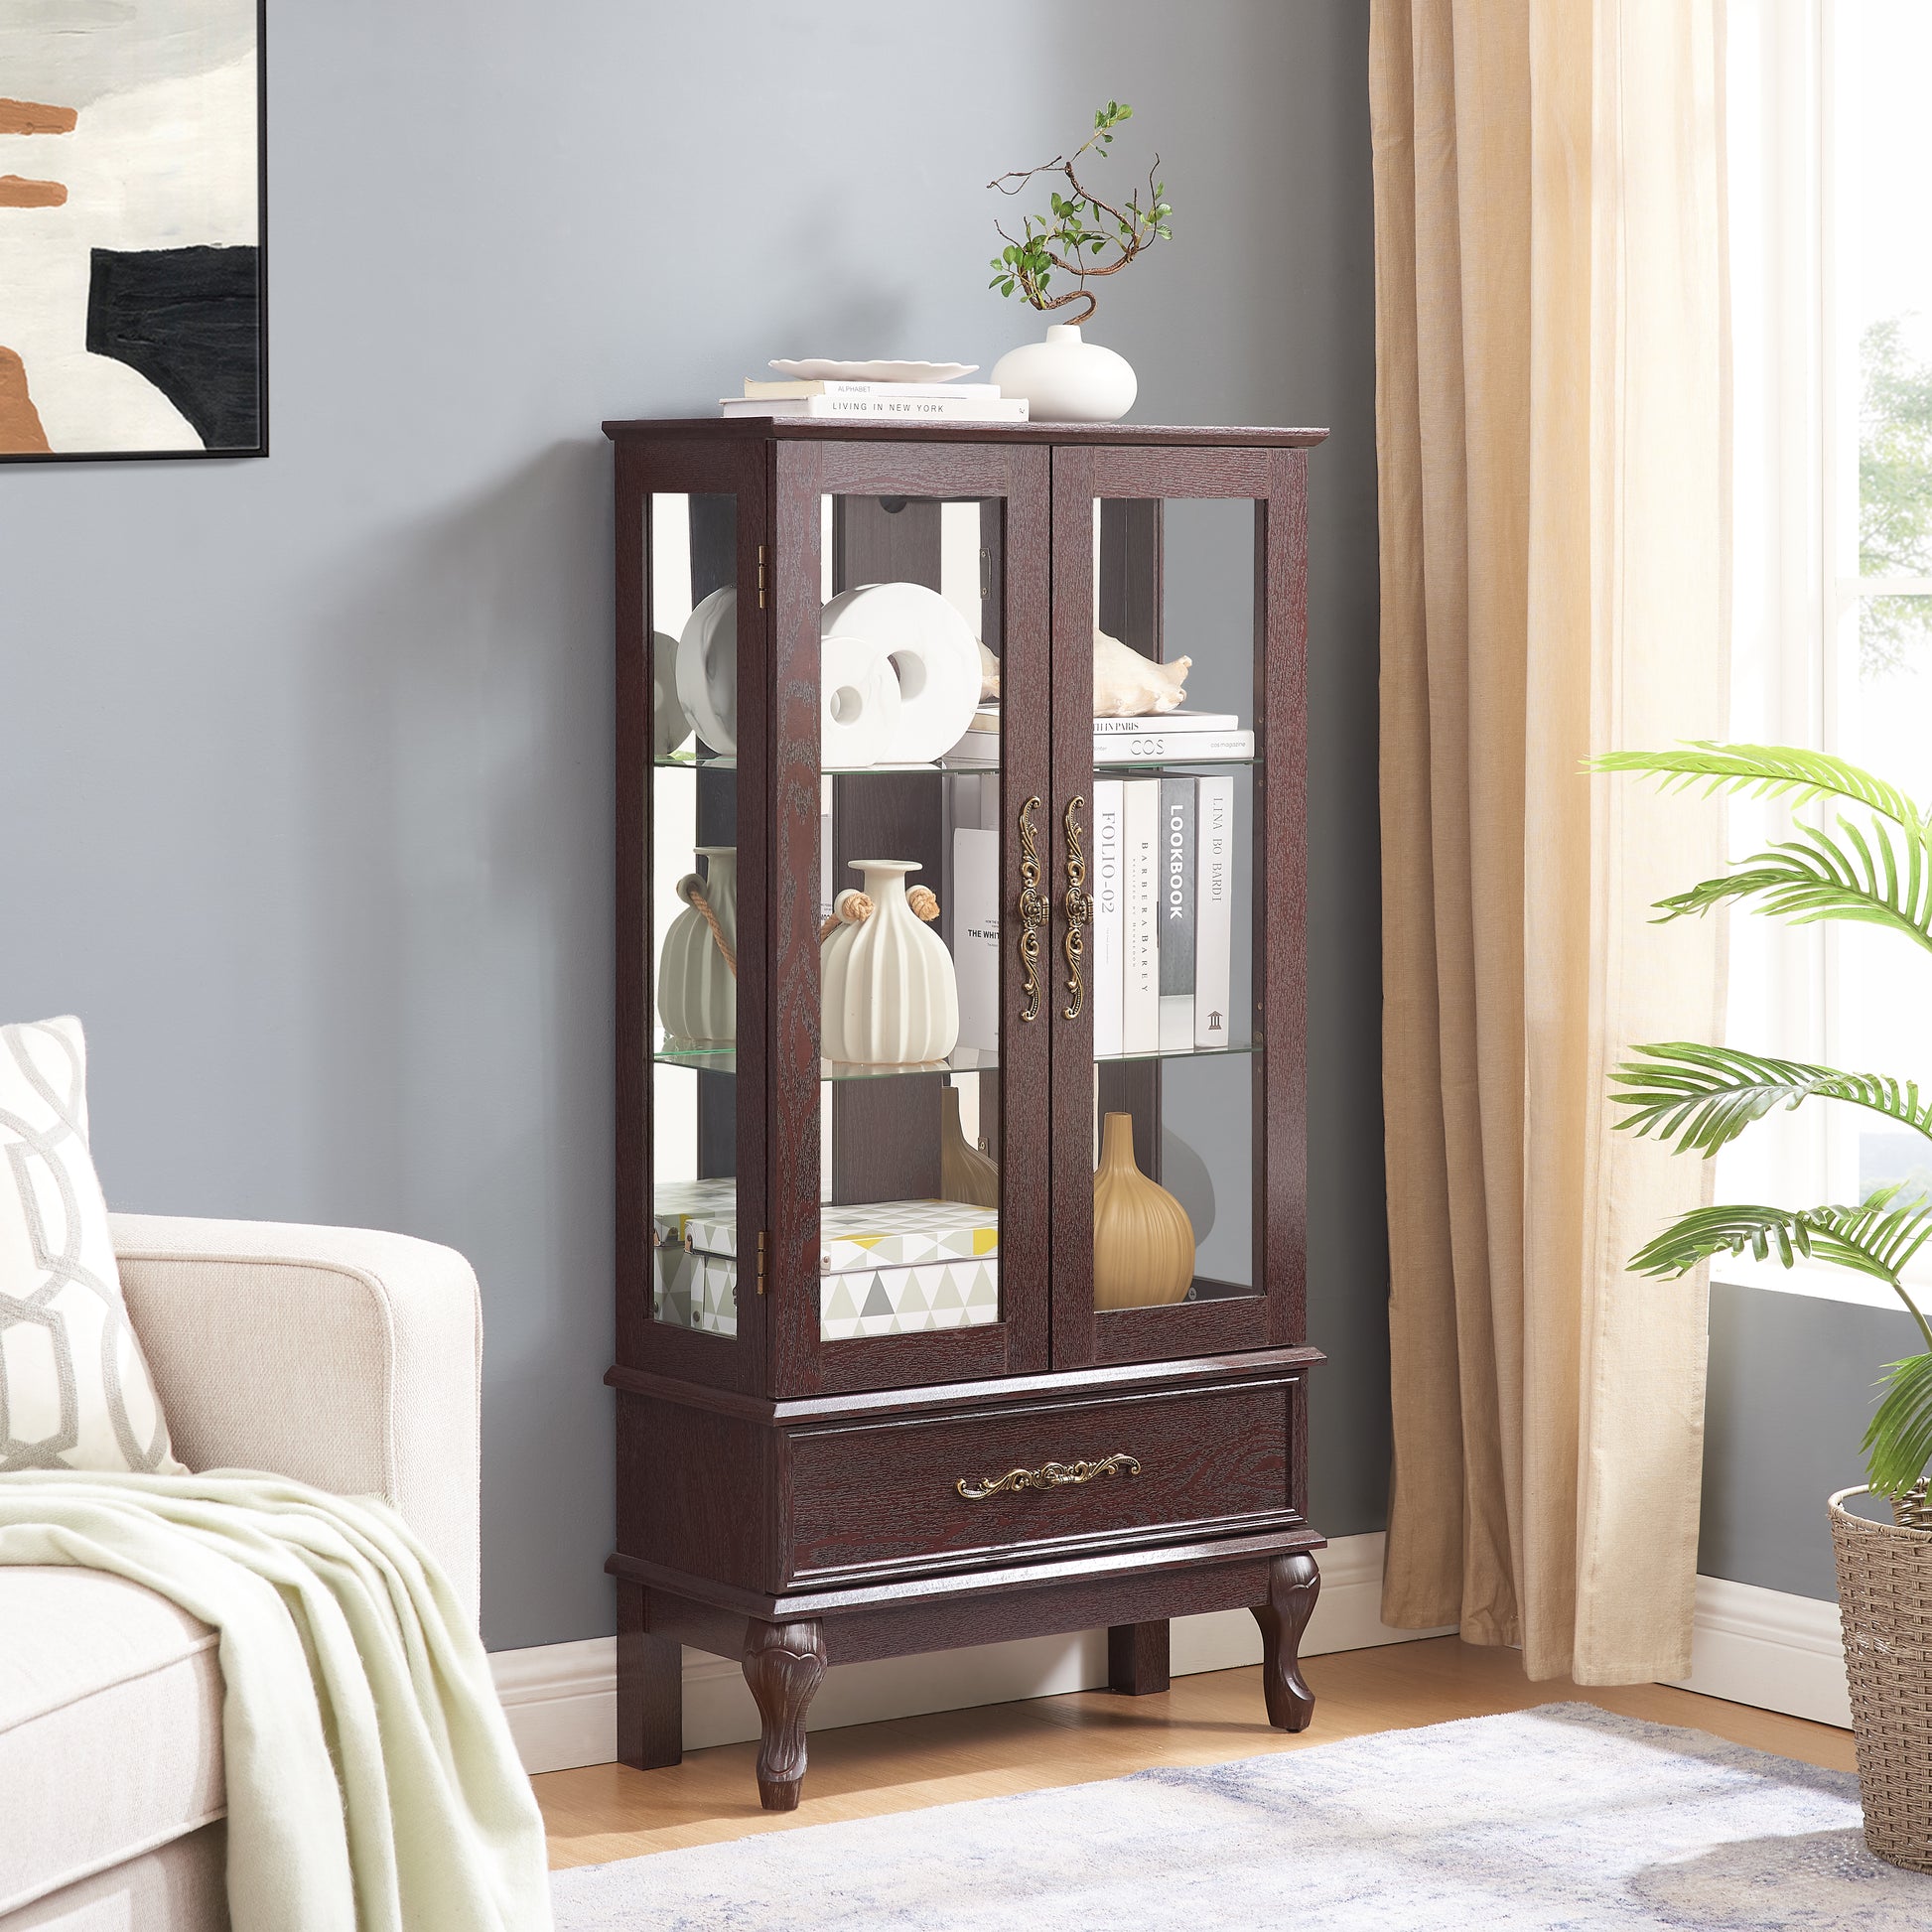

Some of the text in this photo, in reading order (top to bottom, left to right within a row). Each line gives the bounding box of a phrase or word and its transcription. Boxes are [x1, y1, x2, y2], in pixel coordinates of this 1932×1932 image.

[832, 402, 868, 411] LIVING
[916, 404, 944, 413] YORK
[1115, 722, 1139, 731] PARIS
[1131, 740, 1165, 755] COS
[1101, 811, 1116, 913] FOLIO-02
[1170, 804, 1183, 919] LOOKBOOK
[1211, 797, 1223, 902] LINA BO BARDI
